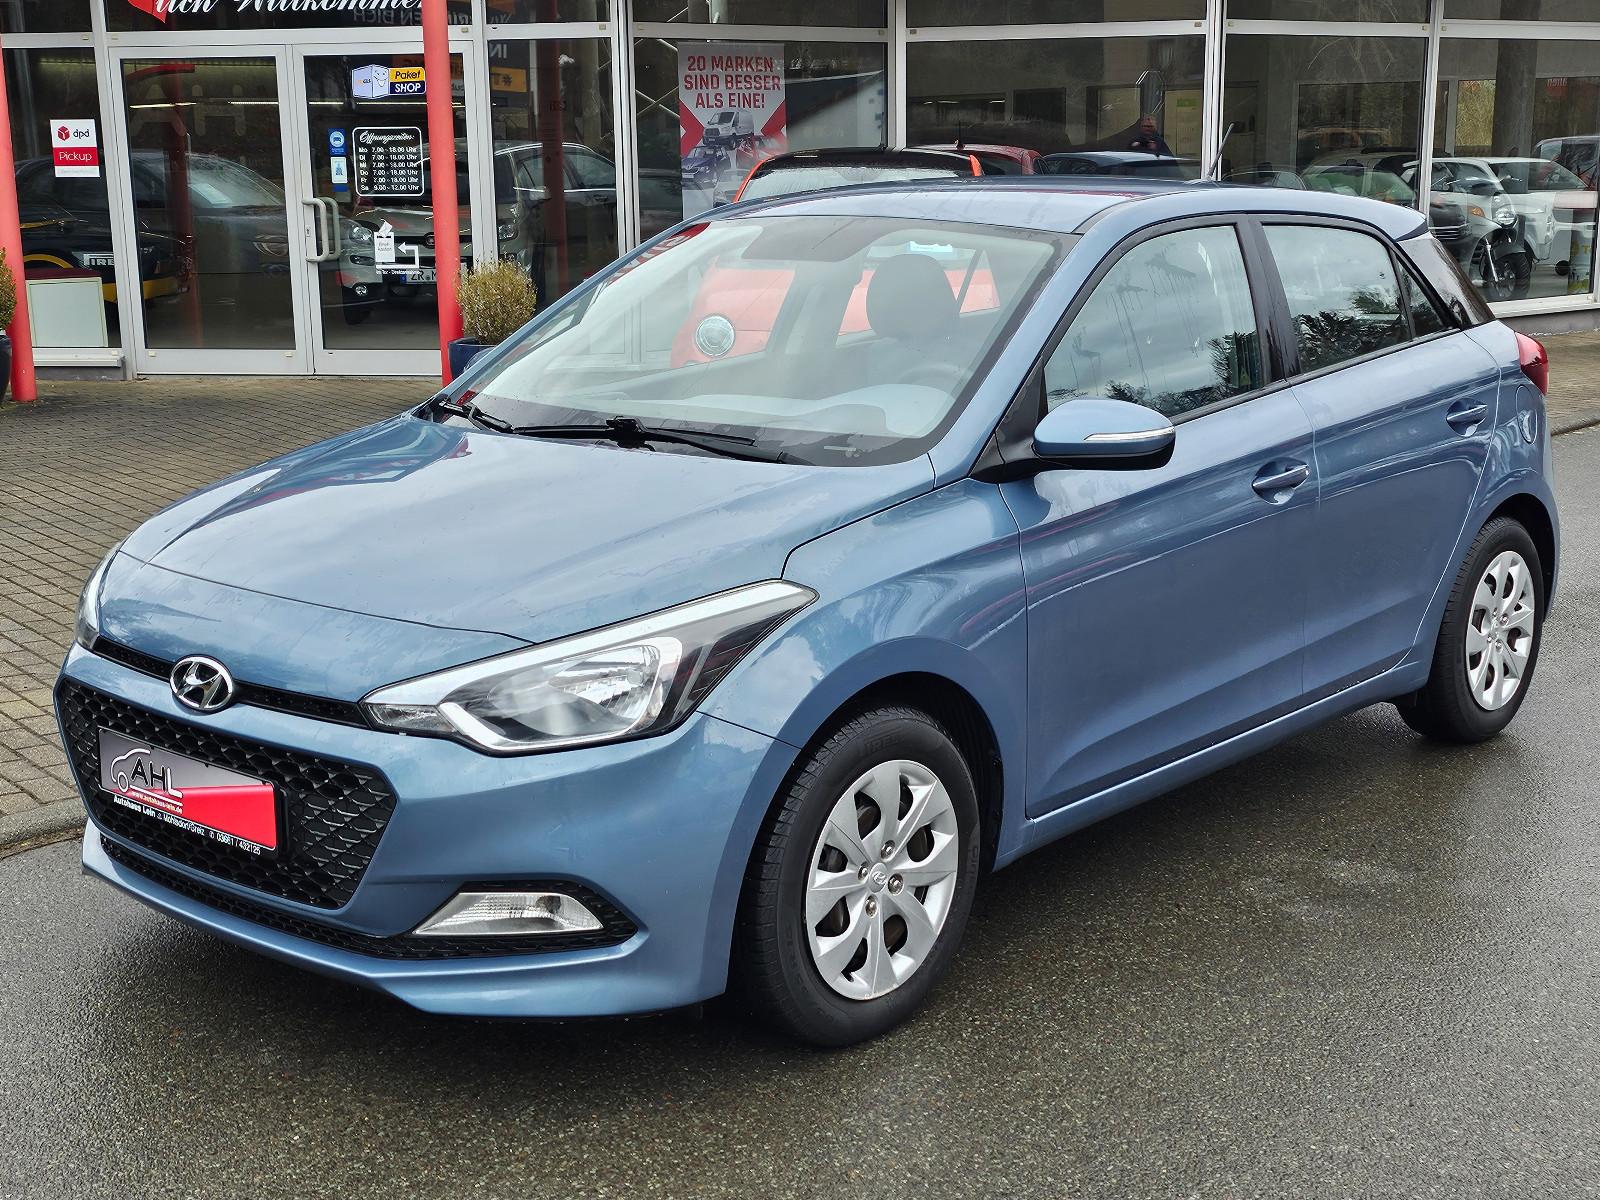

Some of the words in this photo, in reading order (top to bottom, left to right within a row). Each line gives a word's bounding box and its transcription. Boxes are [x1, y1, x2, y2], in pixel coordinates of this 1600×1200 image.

[687, 55, 706, 71] 20
[711, 55, 774, 72] MARKEN
[394, 70, 421, 80] Paket
[684, 74, 720, 90] SIND
[725, 74, 781, 91] BESSER
[394, 83, 421, 92] SHOP
[695, 92, 724, 108] ALS
[728, 93, 766, 108] EINE!
[73, 128, 90, 139] dpd
[59, 151, 93, 162] Pickup
[130, 756, 184, 799] AHL
[113, 794, 142, 813] Autohaus
[142, 805, 156, 818] Lein
